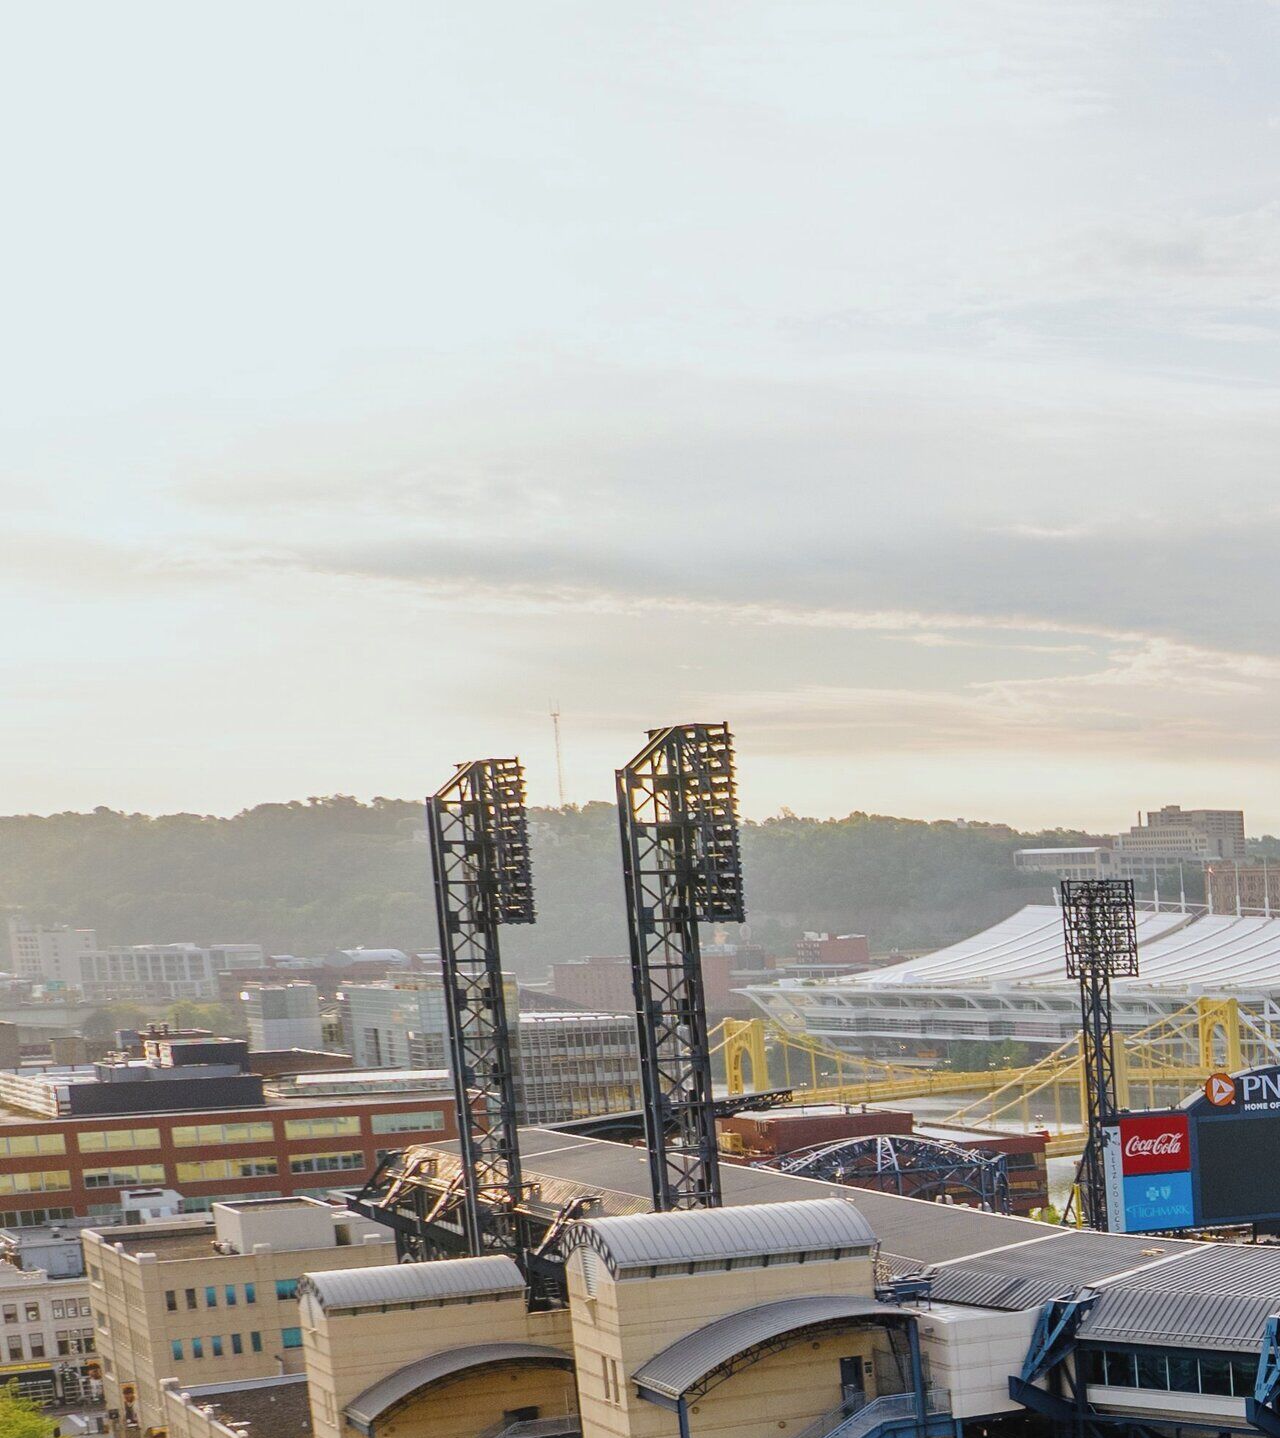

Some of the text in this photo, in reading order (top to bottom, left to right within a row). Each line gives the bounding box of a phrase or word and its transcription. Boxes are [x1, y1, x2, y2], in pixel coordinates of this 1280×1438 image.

[1244, 1102, 1268, 1111] HOME
[1125, 1133, 1184, 1157] Coca-Cola
[1129, 1203, 1190, 1218] HIGHMARK
